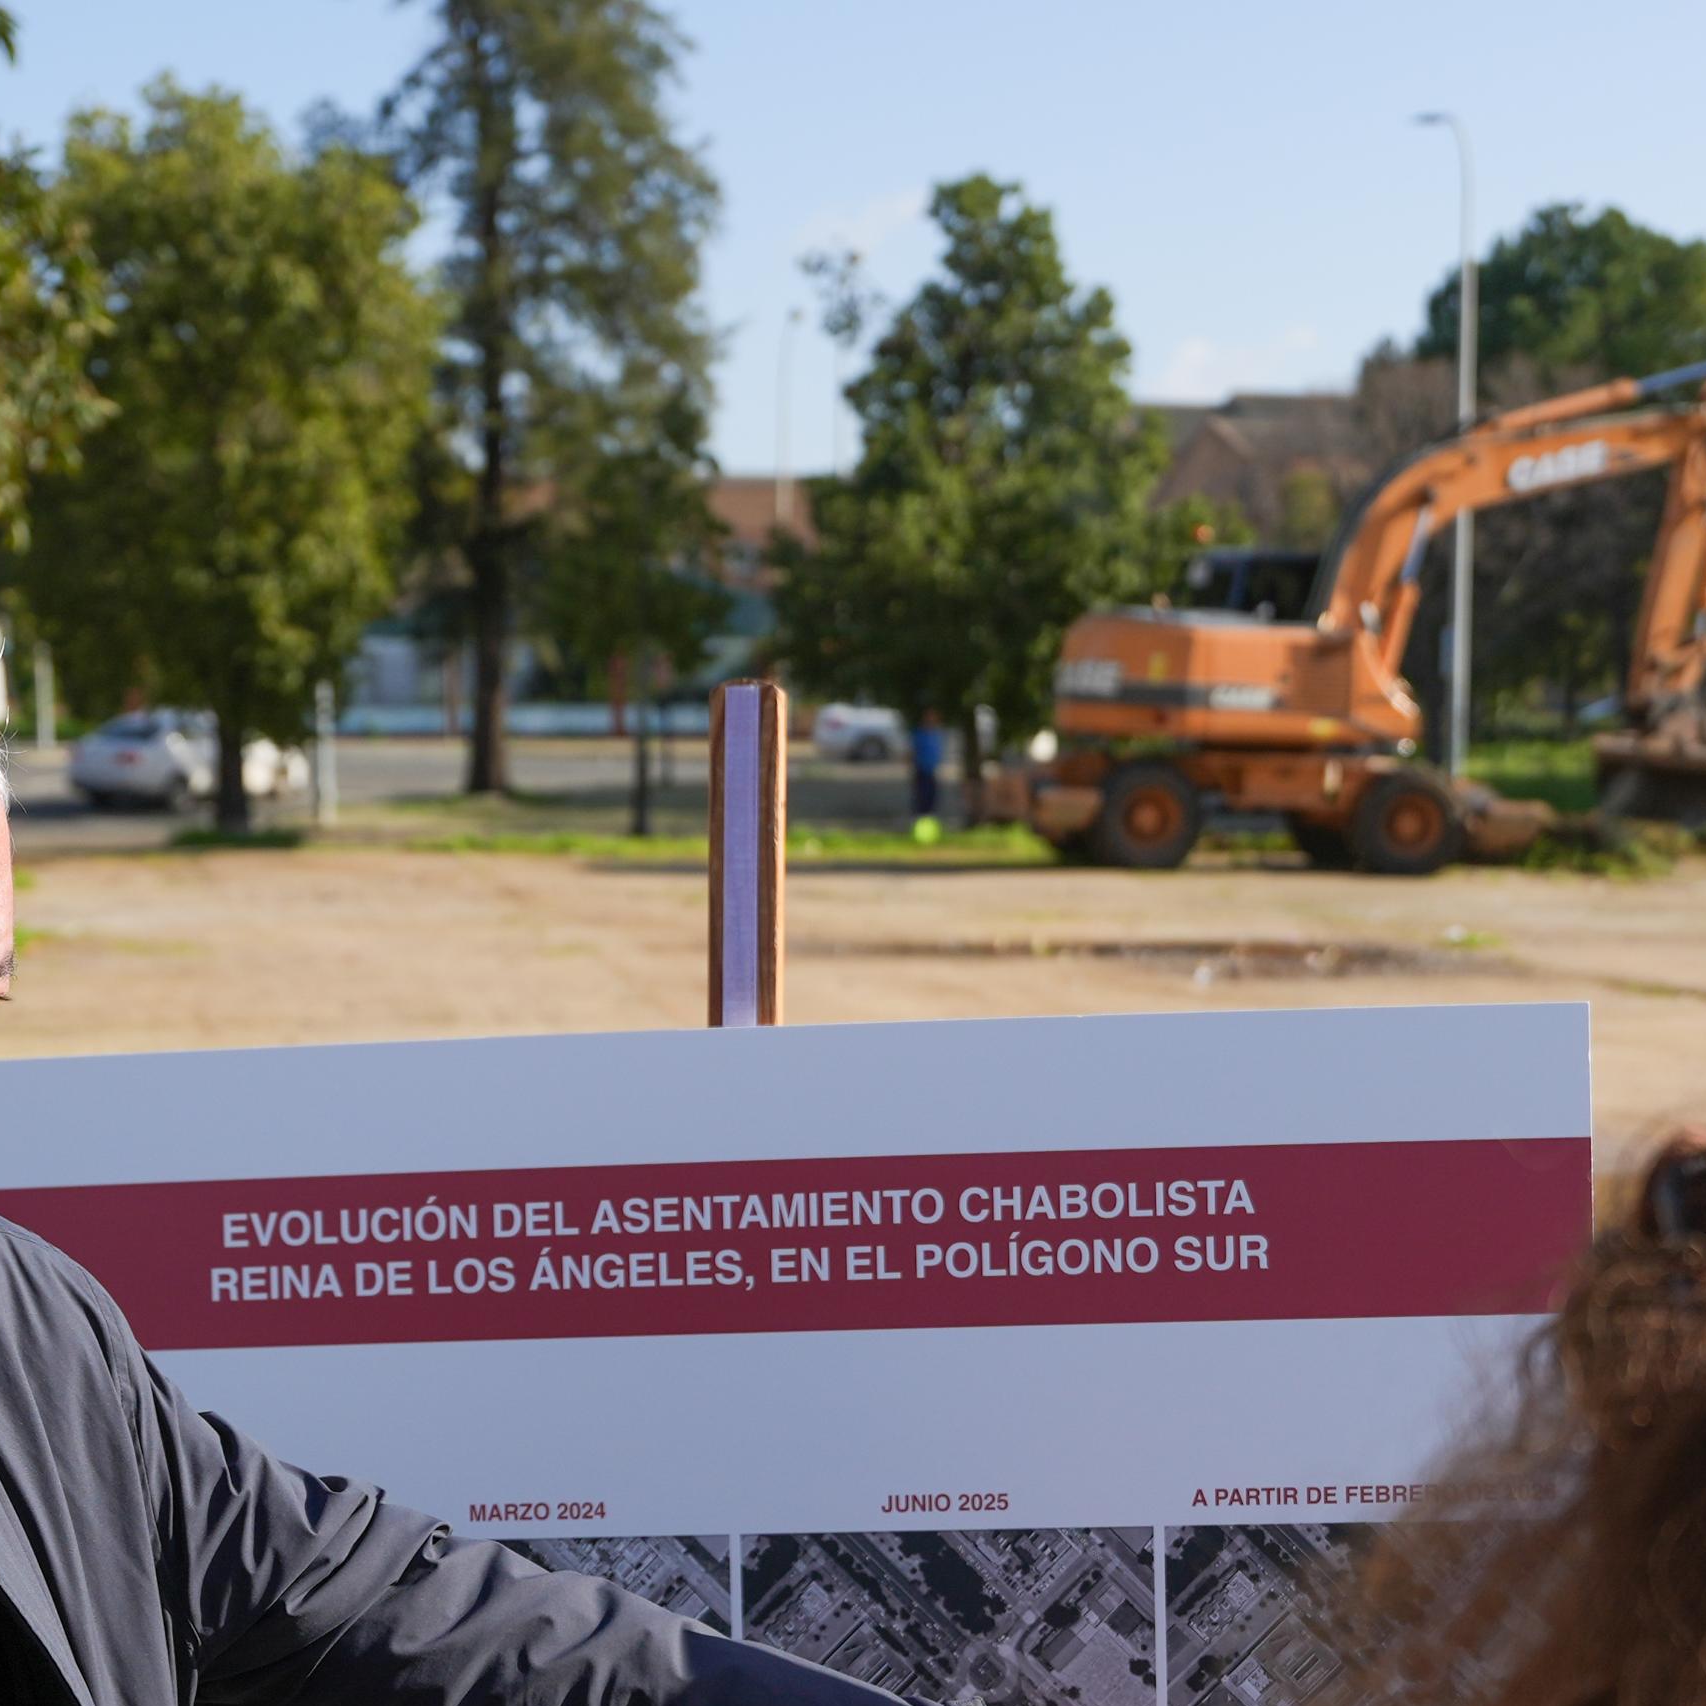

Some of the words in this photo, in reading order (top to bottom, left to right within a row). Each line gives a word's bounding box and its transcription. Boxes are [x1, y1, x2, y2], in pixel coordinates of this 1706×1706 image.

[1507, 437, 1607, 491] CASE
[222, 1195, 478, 1249] EVOLUCIÓN
[492, 1200, 580, 1239] DEL
[590, 1187, 945, 1235] ASENTAMIENTO
[958, 1179, 1256, 1223] CHABOLISTA
[210, 1263, 344, 1302] REINA
[355, 1260, 414, 1297] DE
[427, 1256, 516, 1295] LOS
[529, 1246, 756, 1292] ÁNGELES,
[770, 1246, 831, 1284] EN
[845, 1245, 902, 1281] EL
[915, 1231, 1160, 1280] POLÍGONO
[1173, 1234, 1270, 1273] SUR
[468, 1502, 550, 1523] MARZO
[556, 1501, 607, 1521] 2024
[881, 1493, 951, 1513] JUNIO
[957, 1492, 1009, 1512] 2025
[1192, 1488, 1208, 1507] A
[1214, 1486, 1299, 1506] PARTIR
[1306, 1485, 1338, 1505] DE
[1345, 1483, 1453, 1504] FEBRE
